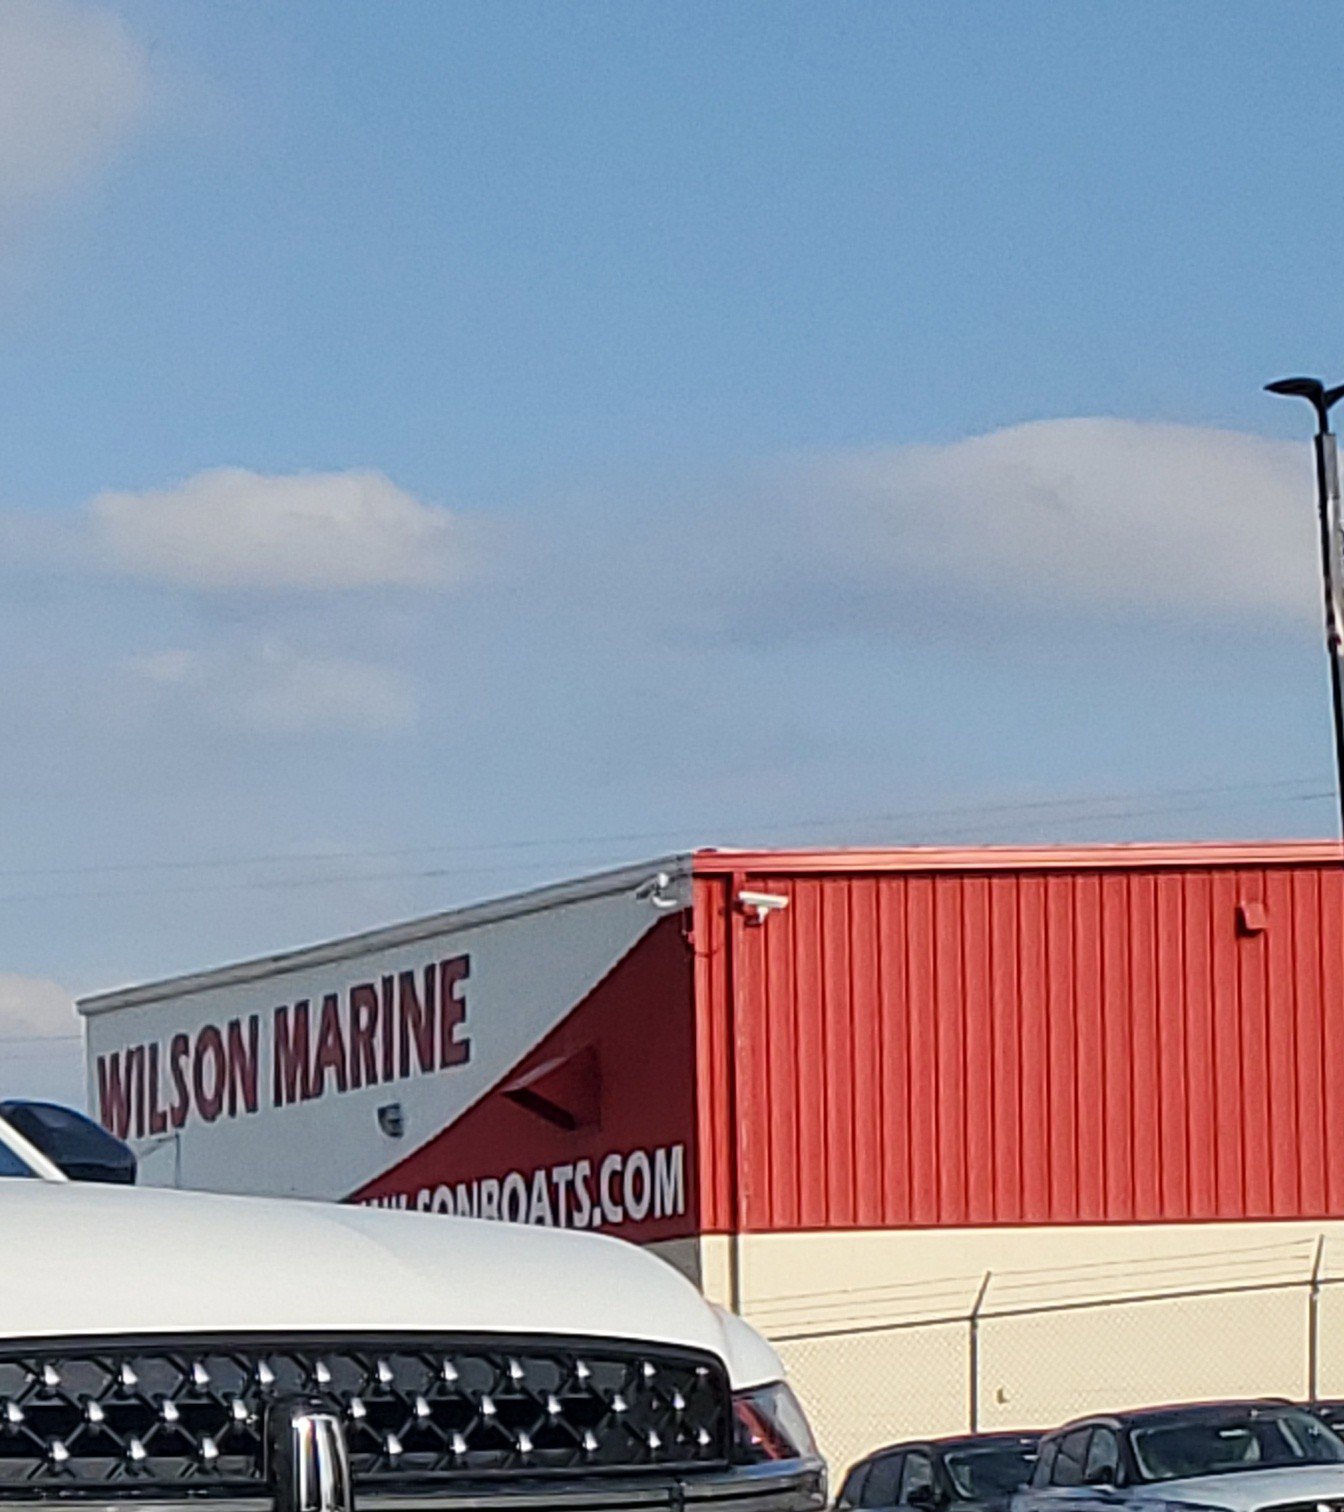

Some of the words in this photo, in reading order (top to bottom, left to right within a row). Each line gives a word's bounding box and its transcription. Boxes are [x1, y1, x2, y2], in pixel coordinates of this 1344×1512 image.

[97, 1013, 260, 1140] WILSON
[273, 953, 471, 1109] MARINE
[361, 1144, 685, 1228] ONBOATS.COM
